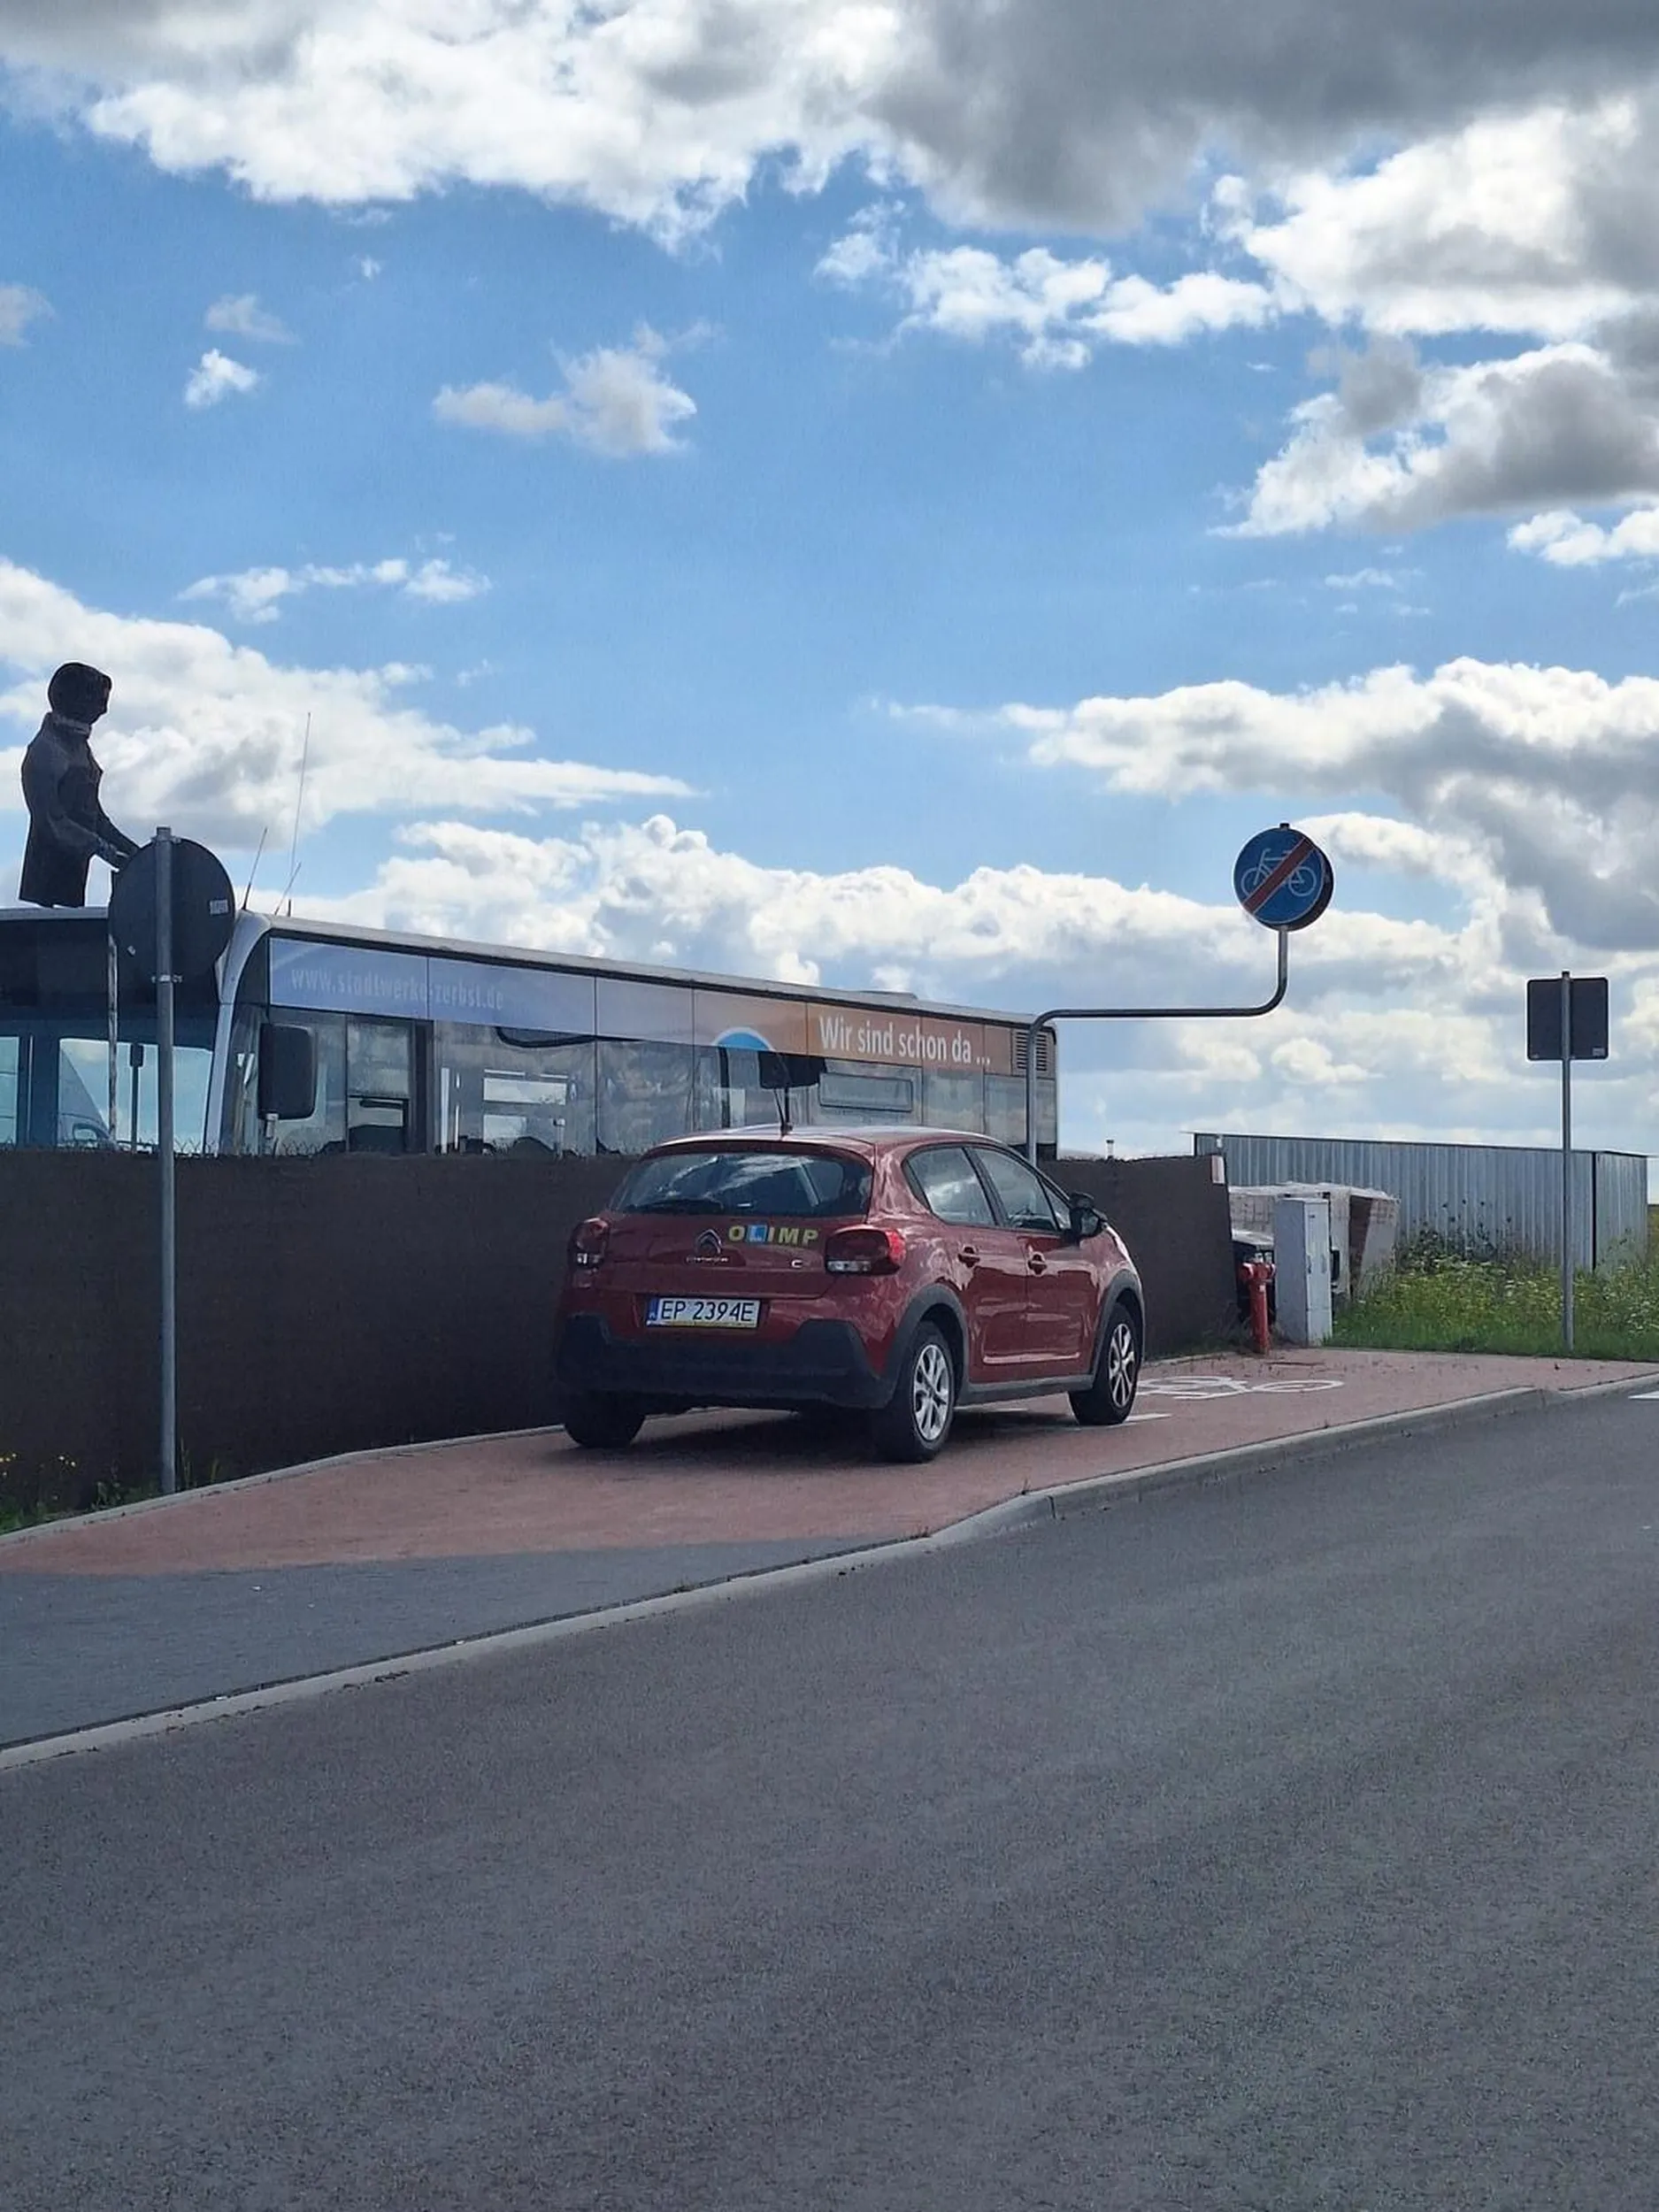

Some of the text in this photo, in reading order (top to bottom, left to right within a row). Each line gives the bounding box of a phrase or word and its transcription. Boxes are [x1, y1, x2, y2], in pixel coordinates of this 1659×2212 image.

[819, 1015, 852, 1051] Wir
[857, 1019, 893, 1056] sind
[898, 1024, 947, 1061] schon
[728, 1224, 818, 1244] OLIMP
[661, 1300, 687, 1319] EP
[692, 1302, 755, 1322] 2394E
